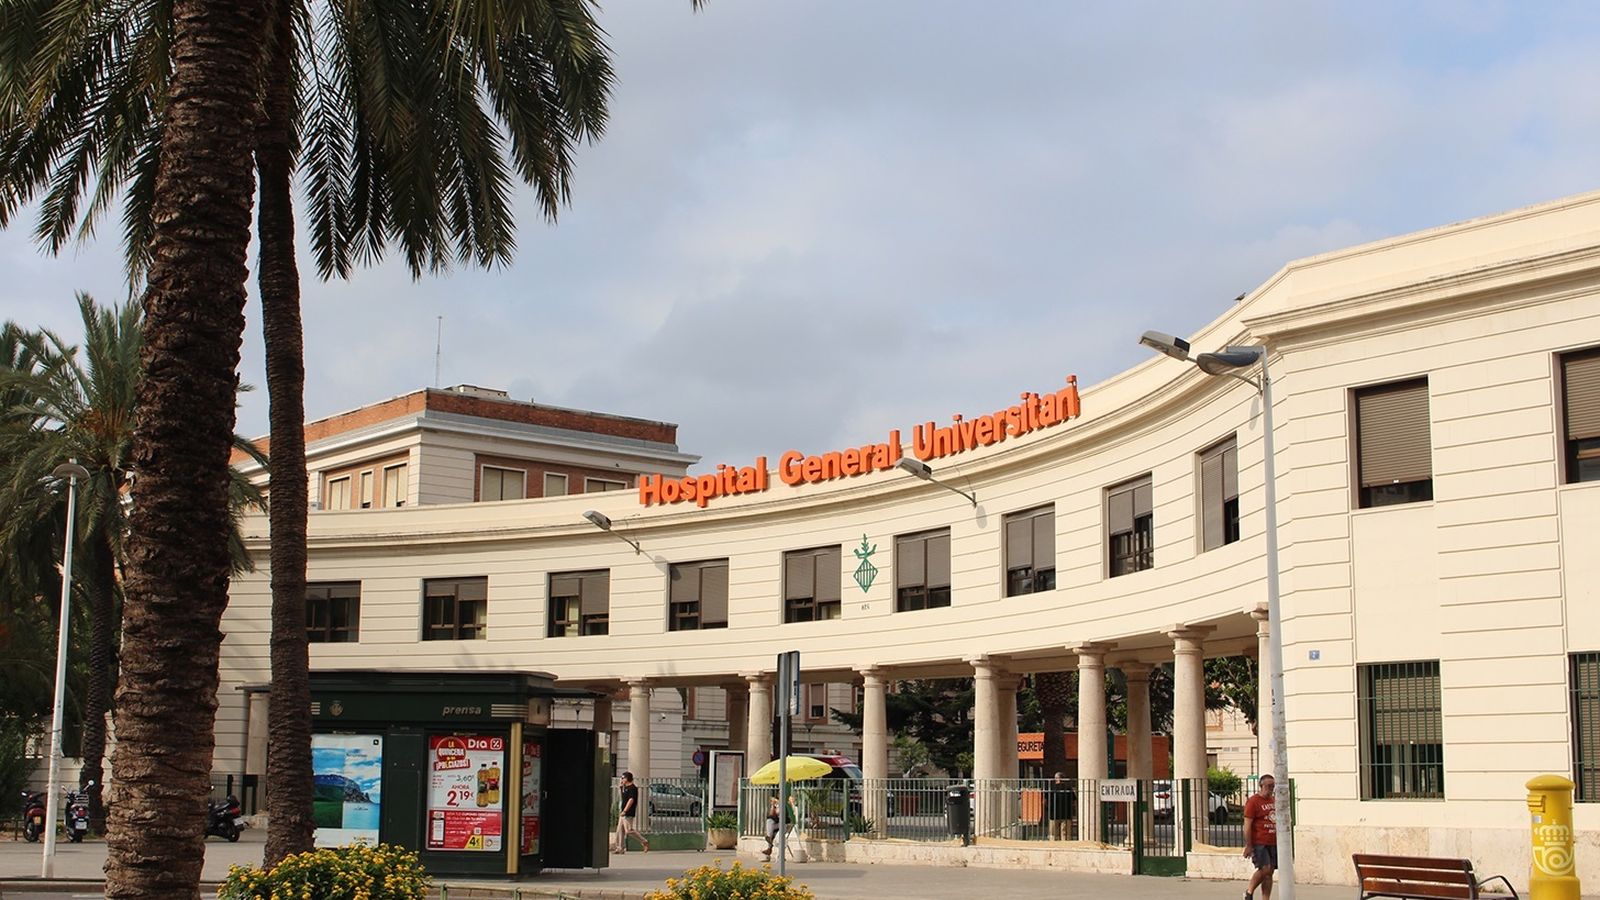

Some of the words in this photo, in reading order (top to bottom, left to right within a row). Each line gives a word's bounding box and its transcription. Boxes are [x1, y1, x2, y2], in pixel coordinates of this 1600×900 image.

[640, 456, 768, 508] Hospital
[780, 429, 902, 486] General
[442, 706, 482, 717] prensa
[1017, 741, 1044, 753] EGURETA
[1101, 785, 1136, 796] ENTRADA
